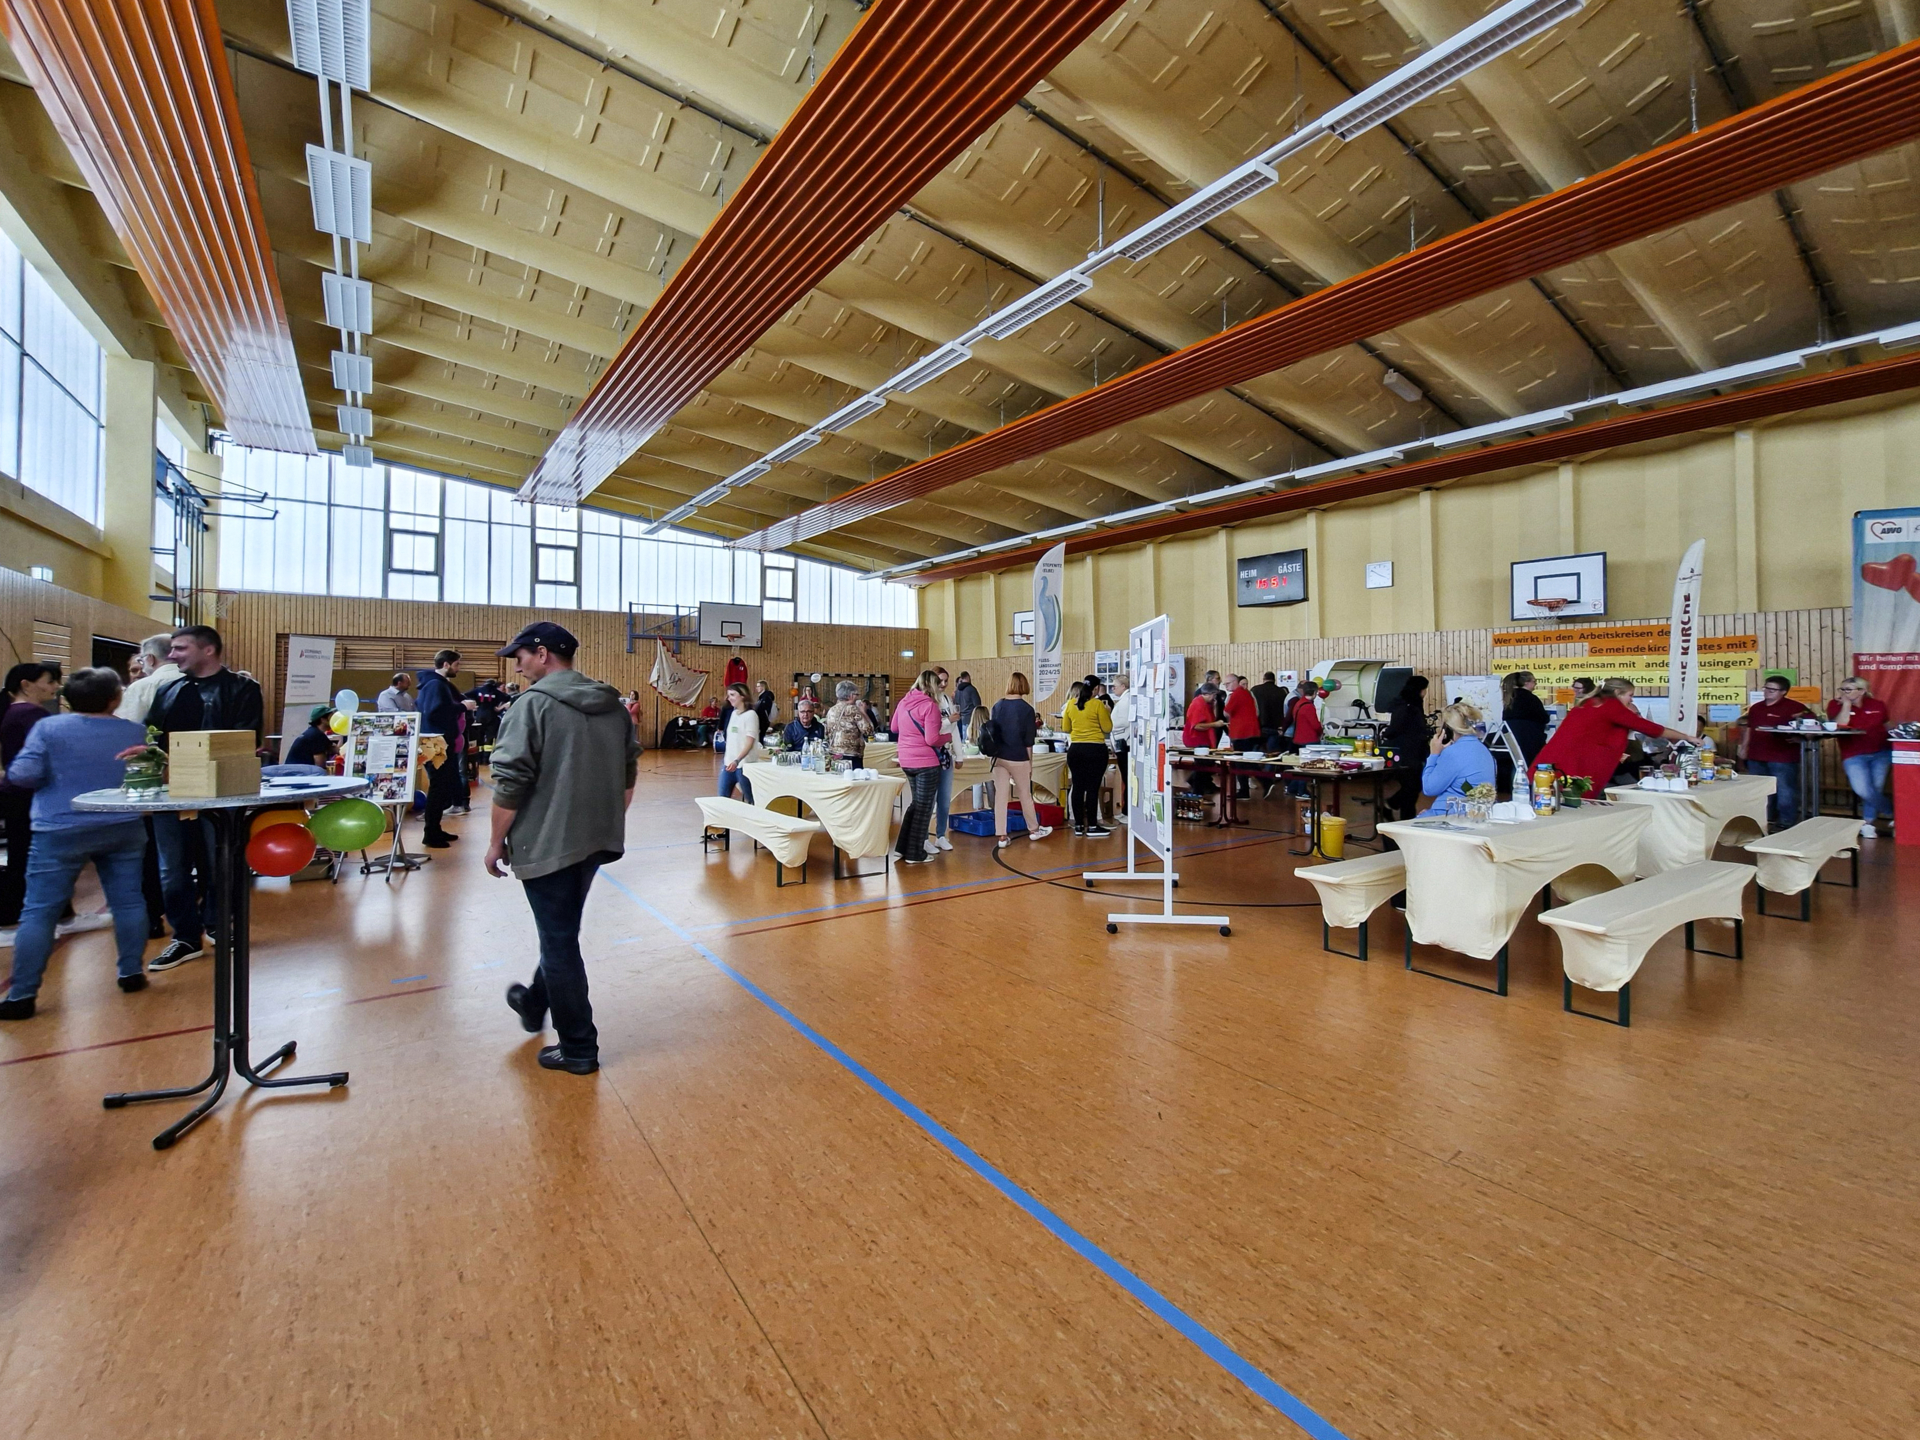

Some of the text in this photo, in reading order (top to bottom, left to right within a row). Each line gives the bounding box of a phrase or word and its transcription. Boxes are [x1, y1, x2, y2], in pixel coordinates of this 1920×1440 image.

[1880, 527, 1902, 535] AWO
[1240, 562, 1301, 579] HEIM GÄSTE
[1493, 637, 1511, 645] Wer
[1515, 635, 1539, 644] wirkt
[1543, 634, 1552, 642] in
[1555, 633, 1574, 642] den
[1578, 629, 1653, 640] Arbeitskreisen
[1726, 640, 1748, 650] mit
[1514, 661, 1530, 670] hat
[1558, 661, 1616, 671] gemeinsam
[1618, 660, 1636, 669] mit
[1555, 675, 1570, 684] die
